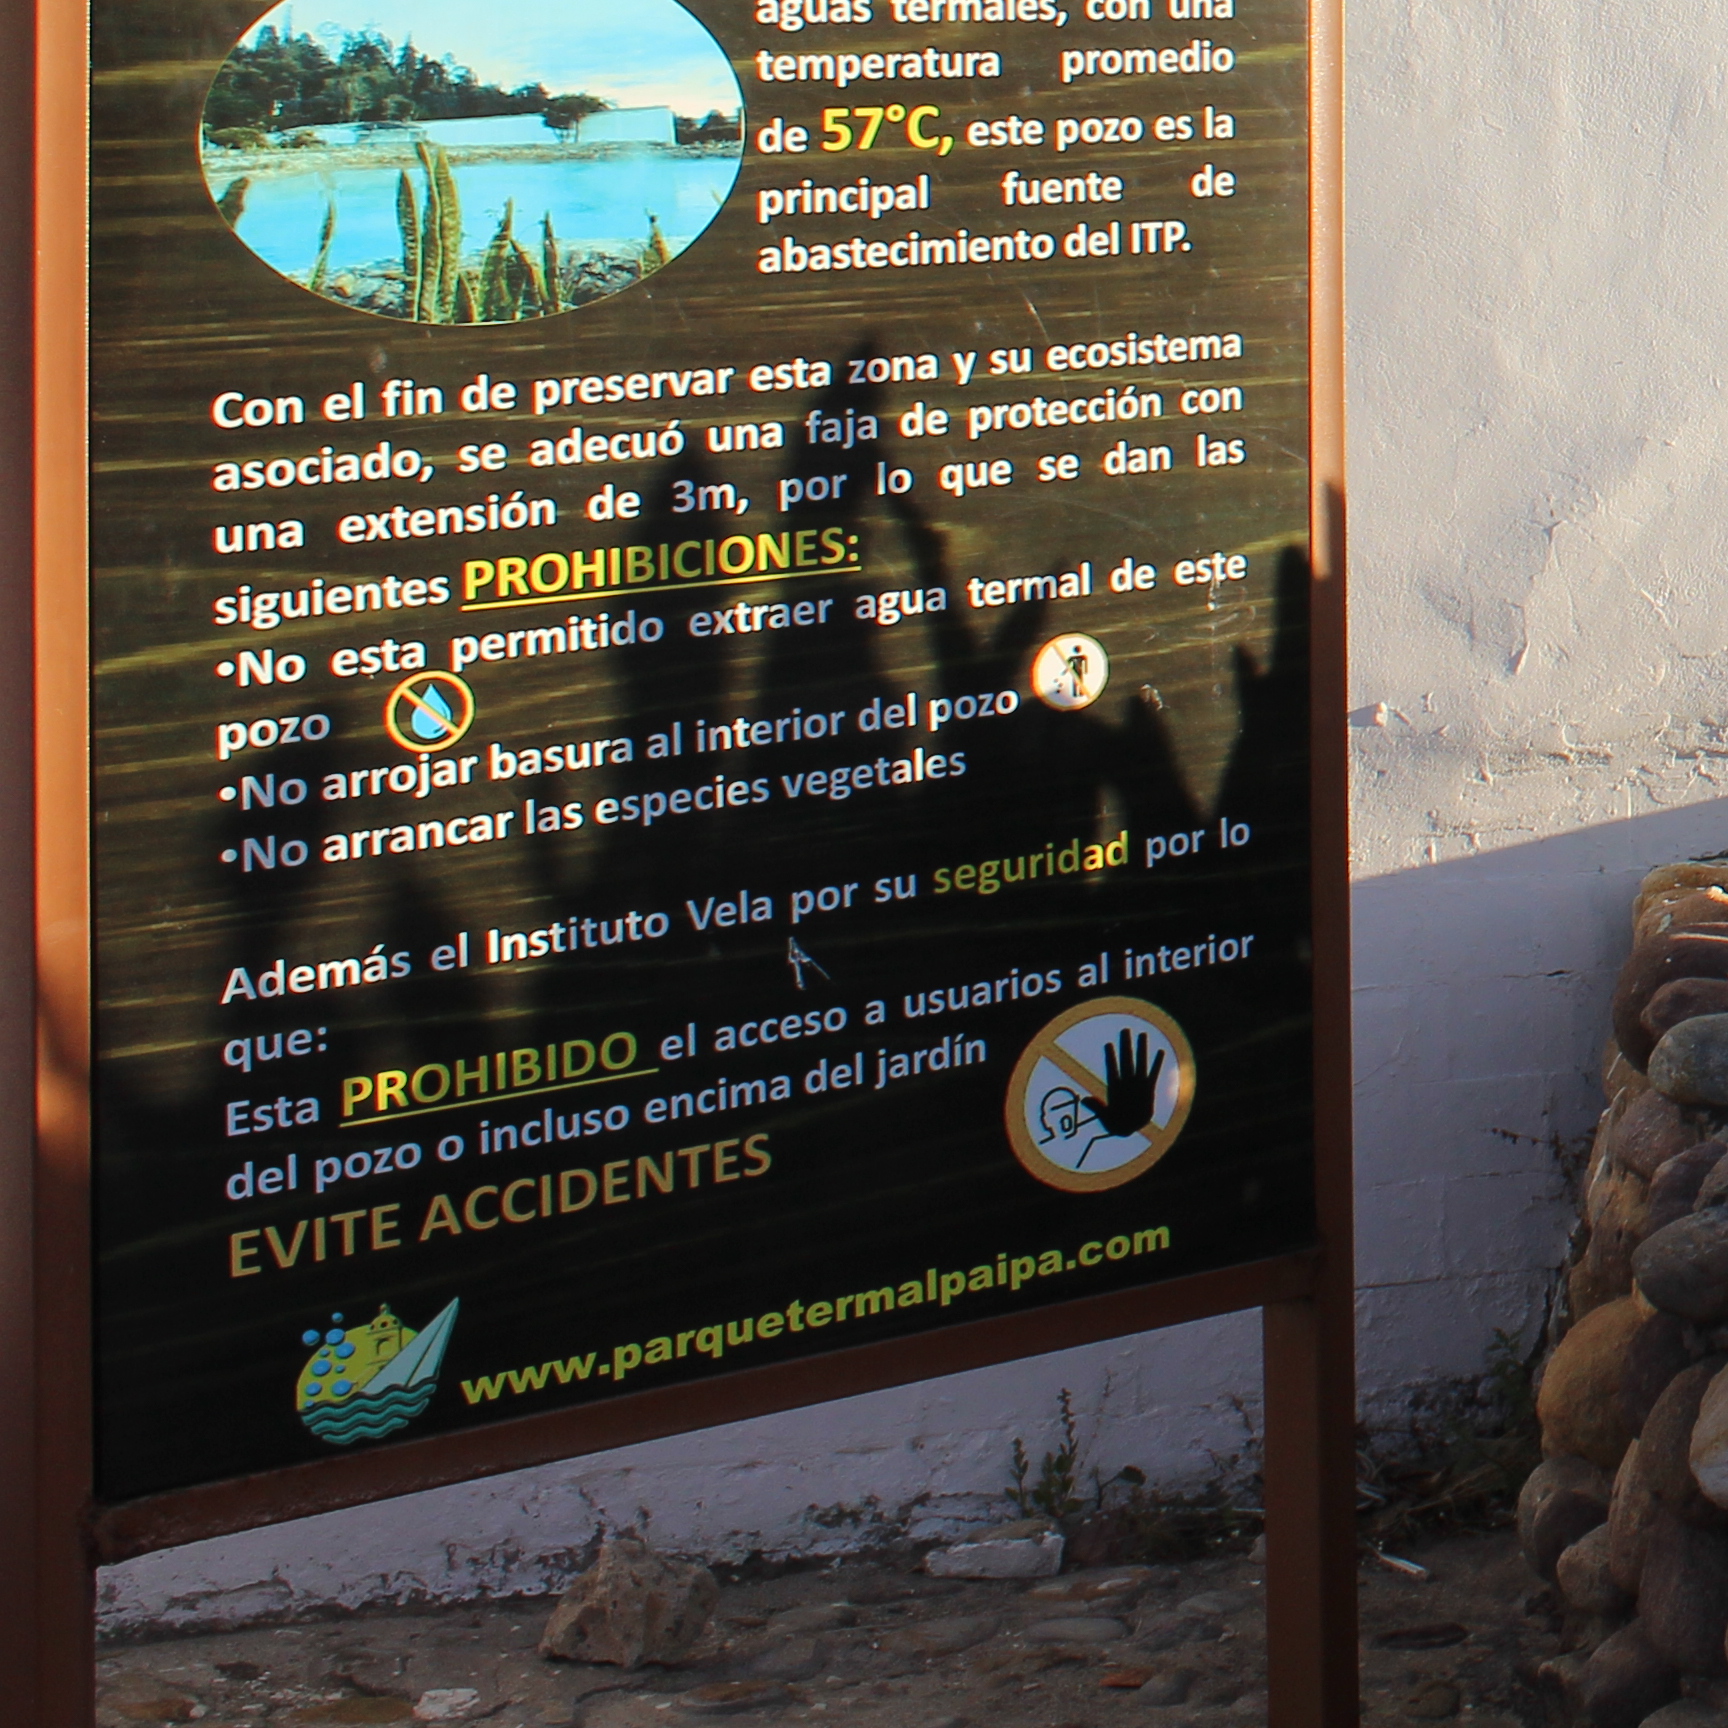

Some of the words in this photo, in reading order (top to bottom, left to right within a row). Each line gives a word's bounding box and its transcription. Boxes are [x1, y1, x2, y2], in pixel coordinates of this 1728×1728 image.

[751, 49, 999, 87] temperatura
[1060, 40, 1233, 82] promedio
[756, 118, 807, 153] de
[821, 105, 952, 155] 57°C,
[965, 116, 1043, 146] este
[1054, 118, 1142, 151] pozo
[1152, 116, 1192, 140] es
[1202, 107, 1233, 138] la
[756, 175, 928, 223] principal
[1000, 172, 1122, 205] fuente
[1189, 164, 1234, 197] de
[756, 230, 1054, 273] abastecimiento
[1062, 222, 1119, 257] del
[1129, 222, 1190, 253] ITP.
[210, 392, 303, 428] Con
[321, 383, 363, 421] el
[379, 380, 442, 417] fin
[458, 375, 516, 412] de
[532, 368, 734, 415] preservar
[746, 358, 831, 391] esta
[849, 355, 937, 383] zona
[950, 352, 976, 385] y
[988, 349, 1031, 375] su
[1044, 333, 1241, 370] ecosistema
[210, 442, 433, 491] asociado,
[455, 444, 506, 472] se
[528, 420, 684, 467] adecuó
[706, 423, 783, 452] una
[805, 409, 877, 449] faja
[897, 402, 948, 437] de
[965, 386, 1161, 439] protección
[1179, 387, 1241, 415] con
[212, 521, 303, 553] una
[336, 491, 555, 543] extensión
[584, 484, 640, 521] de
[673, 480, 748, 514] 3m,
[778, 474, 847, 511] por
[875, 462, 912, 495] lo
[937, 461, 1011, 496] que
[1036, 455, 1079, 481] se
[1100, 441, 1170, 475] dan
[1196, 435, 1244, 467] las
[213, 576, 449, 629] siguientes
[461, 529, 861, 603] PROHIBICIONES:
[329, 640, 424, 677] esta
[449, 610, 664, 672] permitido
[689, 599, 833, 636] extraer
[856, 588, 945, 625] agua
[965, 563, 1090, 608] termal
[1108, 558, 1155, 592] de
[1172, 553, 1246, 591] este
[215, 715, 330, 760] pozo
[322, 754, 478, 800] arrojar
[487, 738, 632, 780] basura
[647, 722, 681, 758] al
[697, 708, 845, 752] interior
[858, 693, 916, 732] del
[926, 691, 1019, 732] pozo
[321, 812, 514, 862] arrancar
[525, 799, 583, 834] las
[592, 775, 770, 826] especies
[782, 748, 966, 800] vegetales
[221, 944, 411, 1004] Además
[431, 932, 467, 970] el
[486, 911, 669, 963] Instituto
[686, 890, 772, 930] Vela
[791, 883, 859, 924] por
[875, 874, 916, 902] su
[934, 829, 1128, 894] seguridad
[1146, 830, 1205, 868] por
[1221, 817, 1250, 848] lo
[223, 1027, 327, 1072] que:
[227, 1097, 319, 1136] Esta
[340, 1031, 639, 1118] PROHIBIDO
[661, 1023, 696, 1060] el
[715, 1007, 847, 1051] acceso
[865, 1000, 885, 1025] a
[904, 968, 1062, 1018] usuarios
[1078, 952, 1108, 987] al
[1125, 934, 1254, 979] interior
[226, 1154, 297, 1200] del
[315, 1143, 422, 1193] pozo
[437, 1135, 464, 1161] o
[480, 1105, 630, 1154] incluso
[643, 1069, 791, 1123] encima
[805, 1052, 863, 1094] del
[875, 1033, 986, 1089] jardín
[230, 1203, 401, 1278] EVITE
[419, 1132, 771, 1241] ACCIDENTES
[460, 1220, 1170, 1404] www.parquetermalpaipa.com
